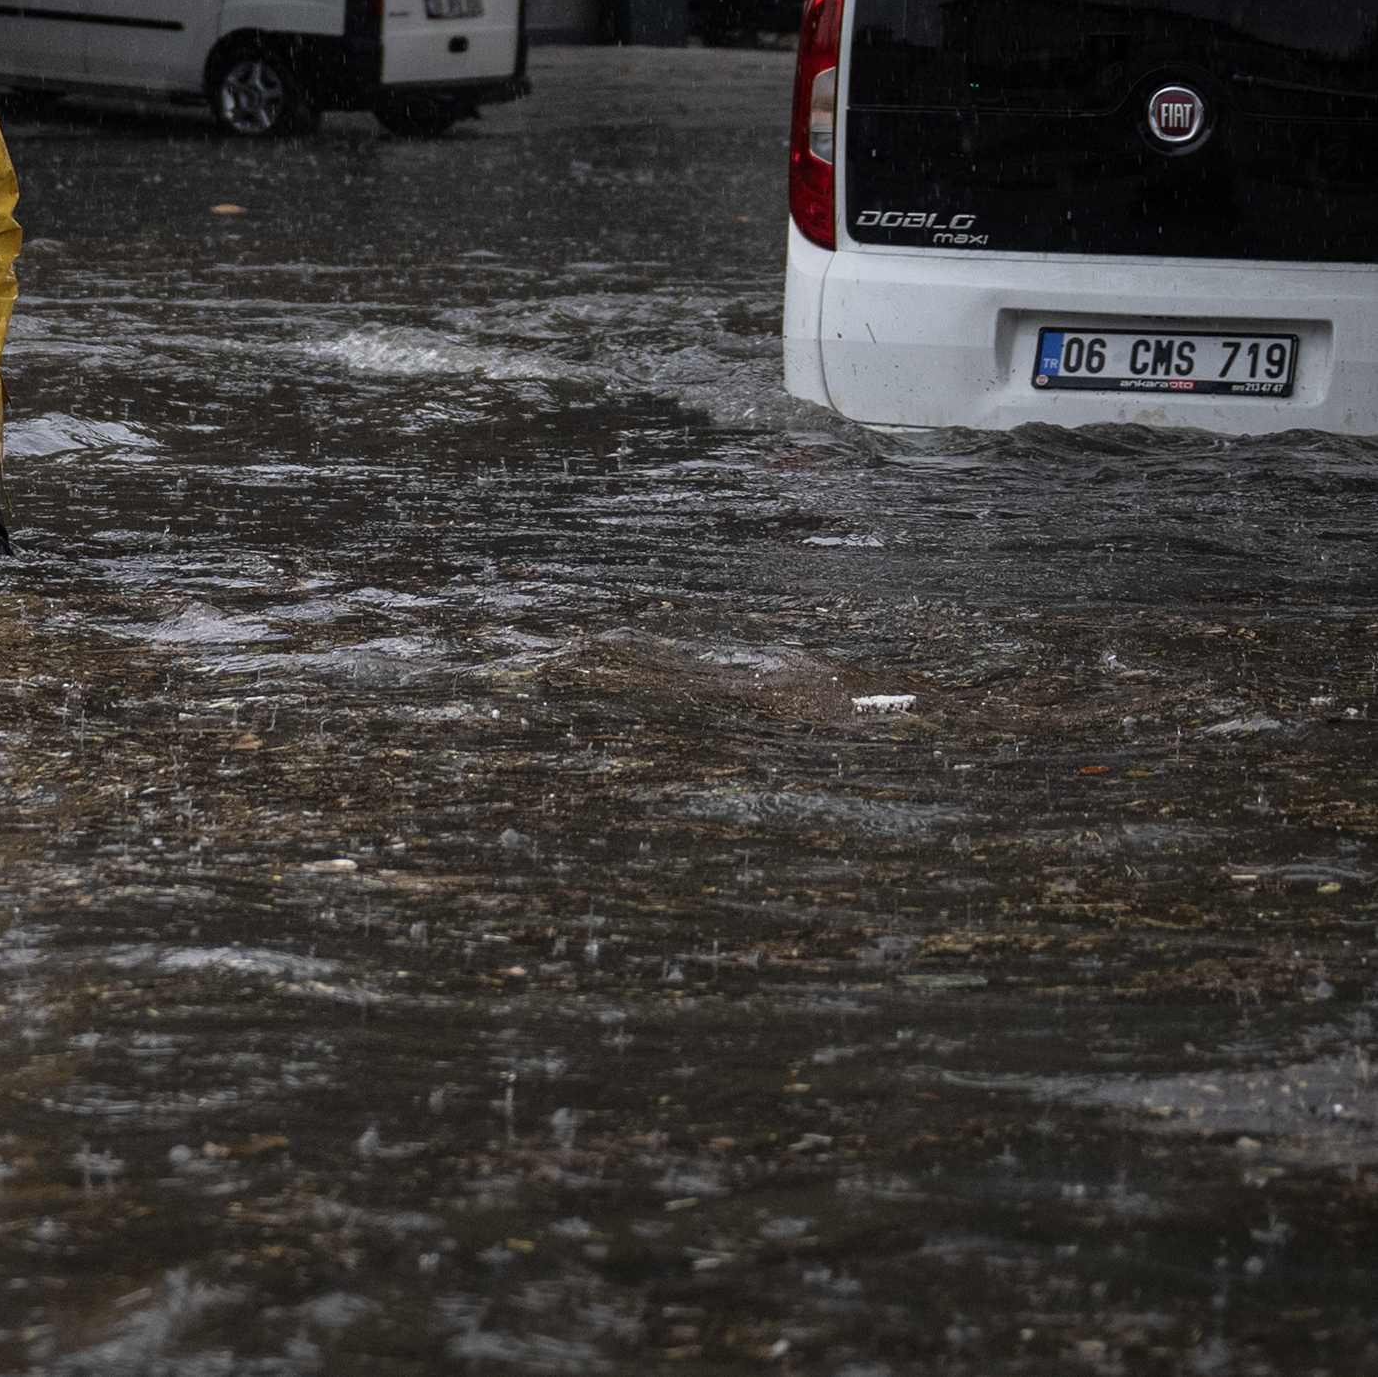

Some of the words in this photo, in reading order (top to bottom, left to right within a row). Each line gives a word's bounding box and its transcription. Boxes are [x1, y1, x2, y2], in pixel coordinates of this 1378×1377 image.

[1160, 102, 1194, 128] FIAT
[854, 210, 976, 230] DOBLO
[1042, 357, 1060, 370] TR
[1064, 337, 1107, 374] 06
[1129, 339, 1196, 377] CMS
[1219, 341, 1287, 379] 719
[1244, 383, 1261, 394] 213
